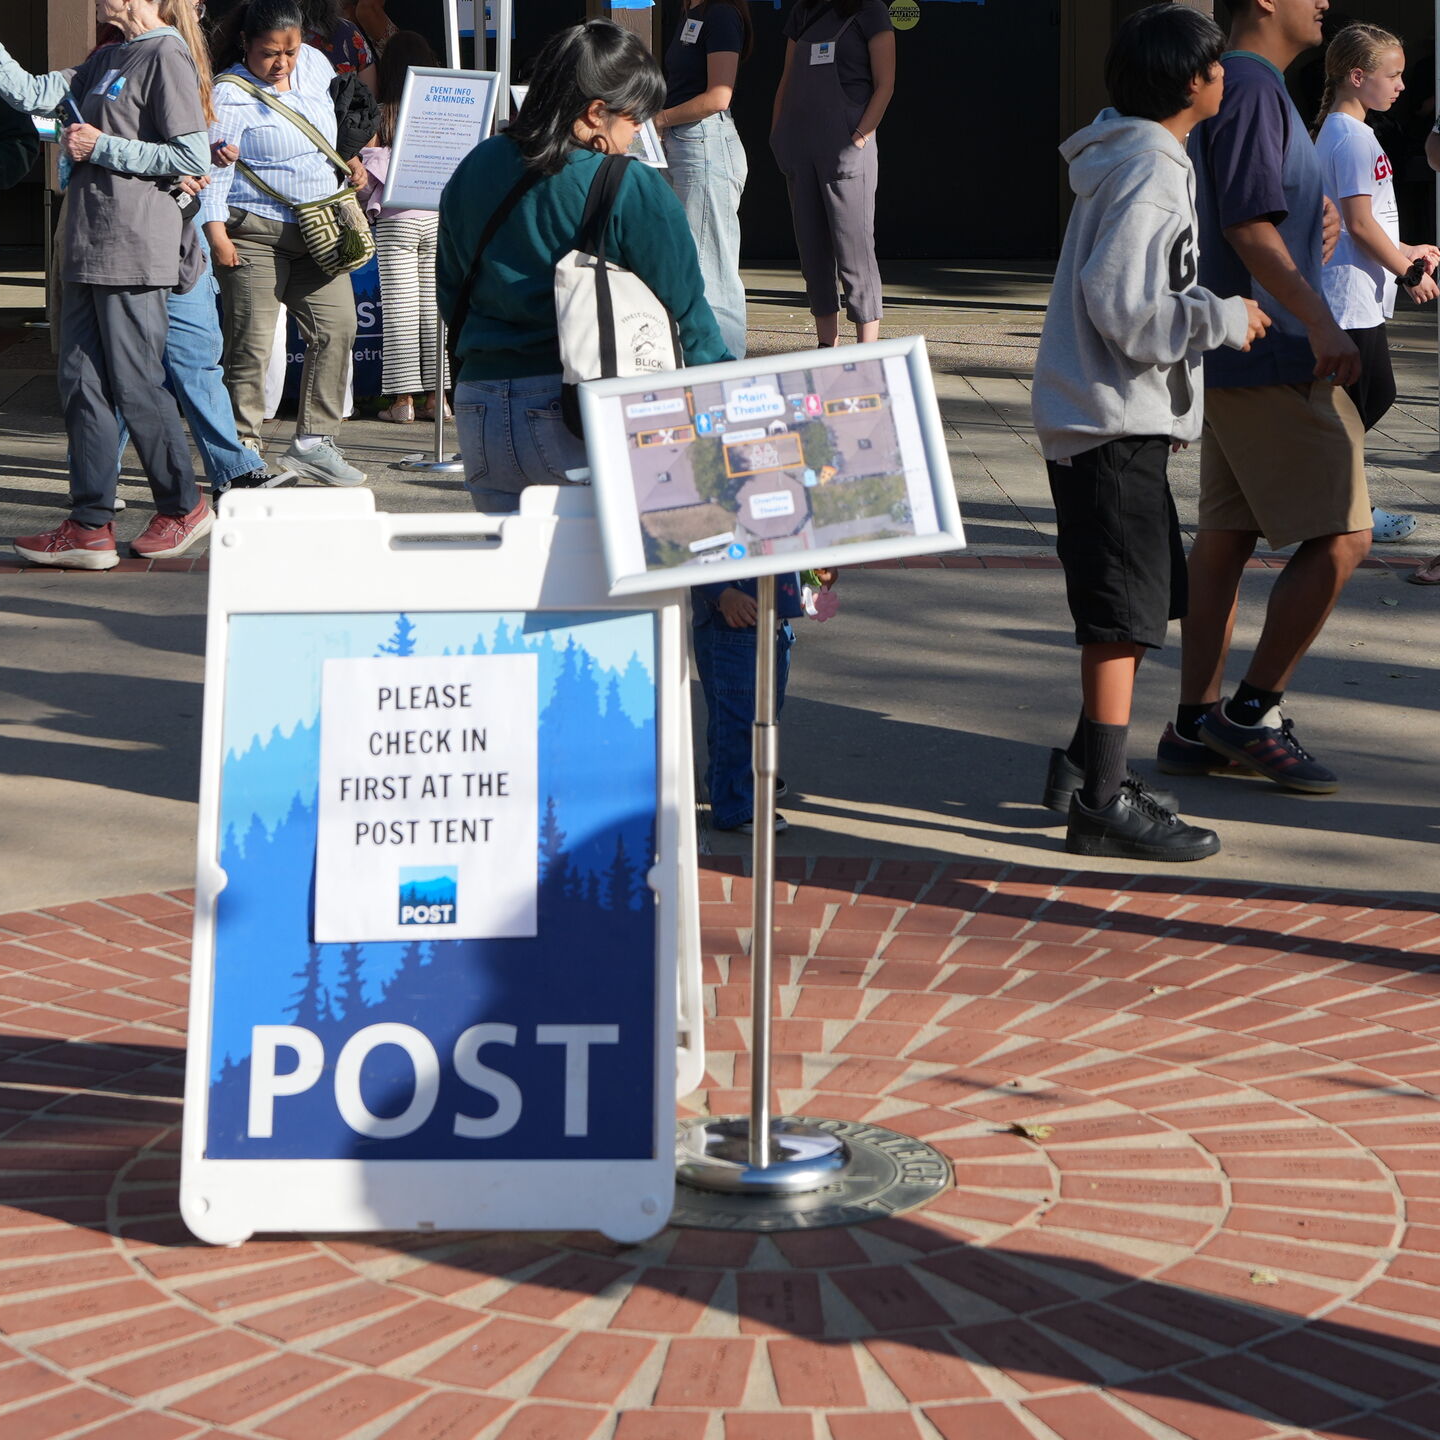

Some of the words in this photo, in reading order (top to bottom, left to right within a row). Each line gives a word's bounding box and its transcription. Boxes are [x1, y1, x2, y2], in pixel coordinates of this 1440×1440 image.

[429, 85, 452, 94] EVENT
[454, 88, 471, 96] INFO
[432, 95, 475, 105] REMINDERS
[635, 357, 663, 369] BLICK
[738, 392, 767, 403] Main
[733, 403, 779, 416] Theatre
[378, 684, 472, 710] PLEASE
[369, 728, 452, 756] CHECK
[462, 728, 487, 752] IN
[340, 775, 412, 801] FIRST
[420, 774, 453, 799] AT
[462, 772, 510, 797] THE
[355, 820, 420, 846] POST
[429, 818, 494, 843] TENT
[401, 904, 454, 923] POST
[246, 1022, 620, 1140] POST
